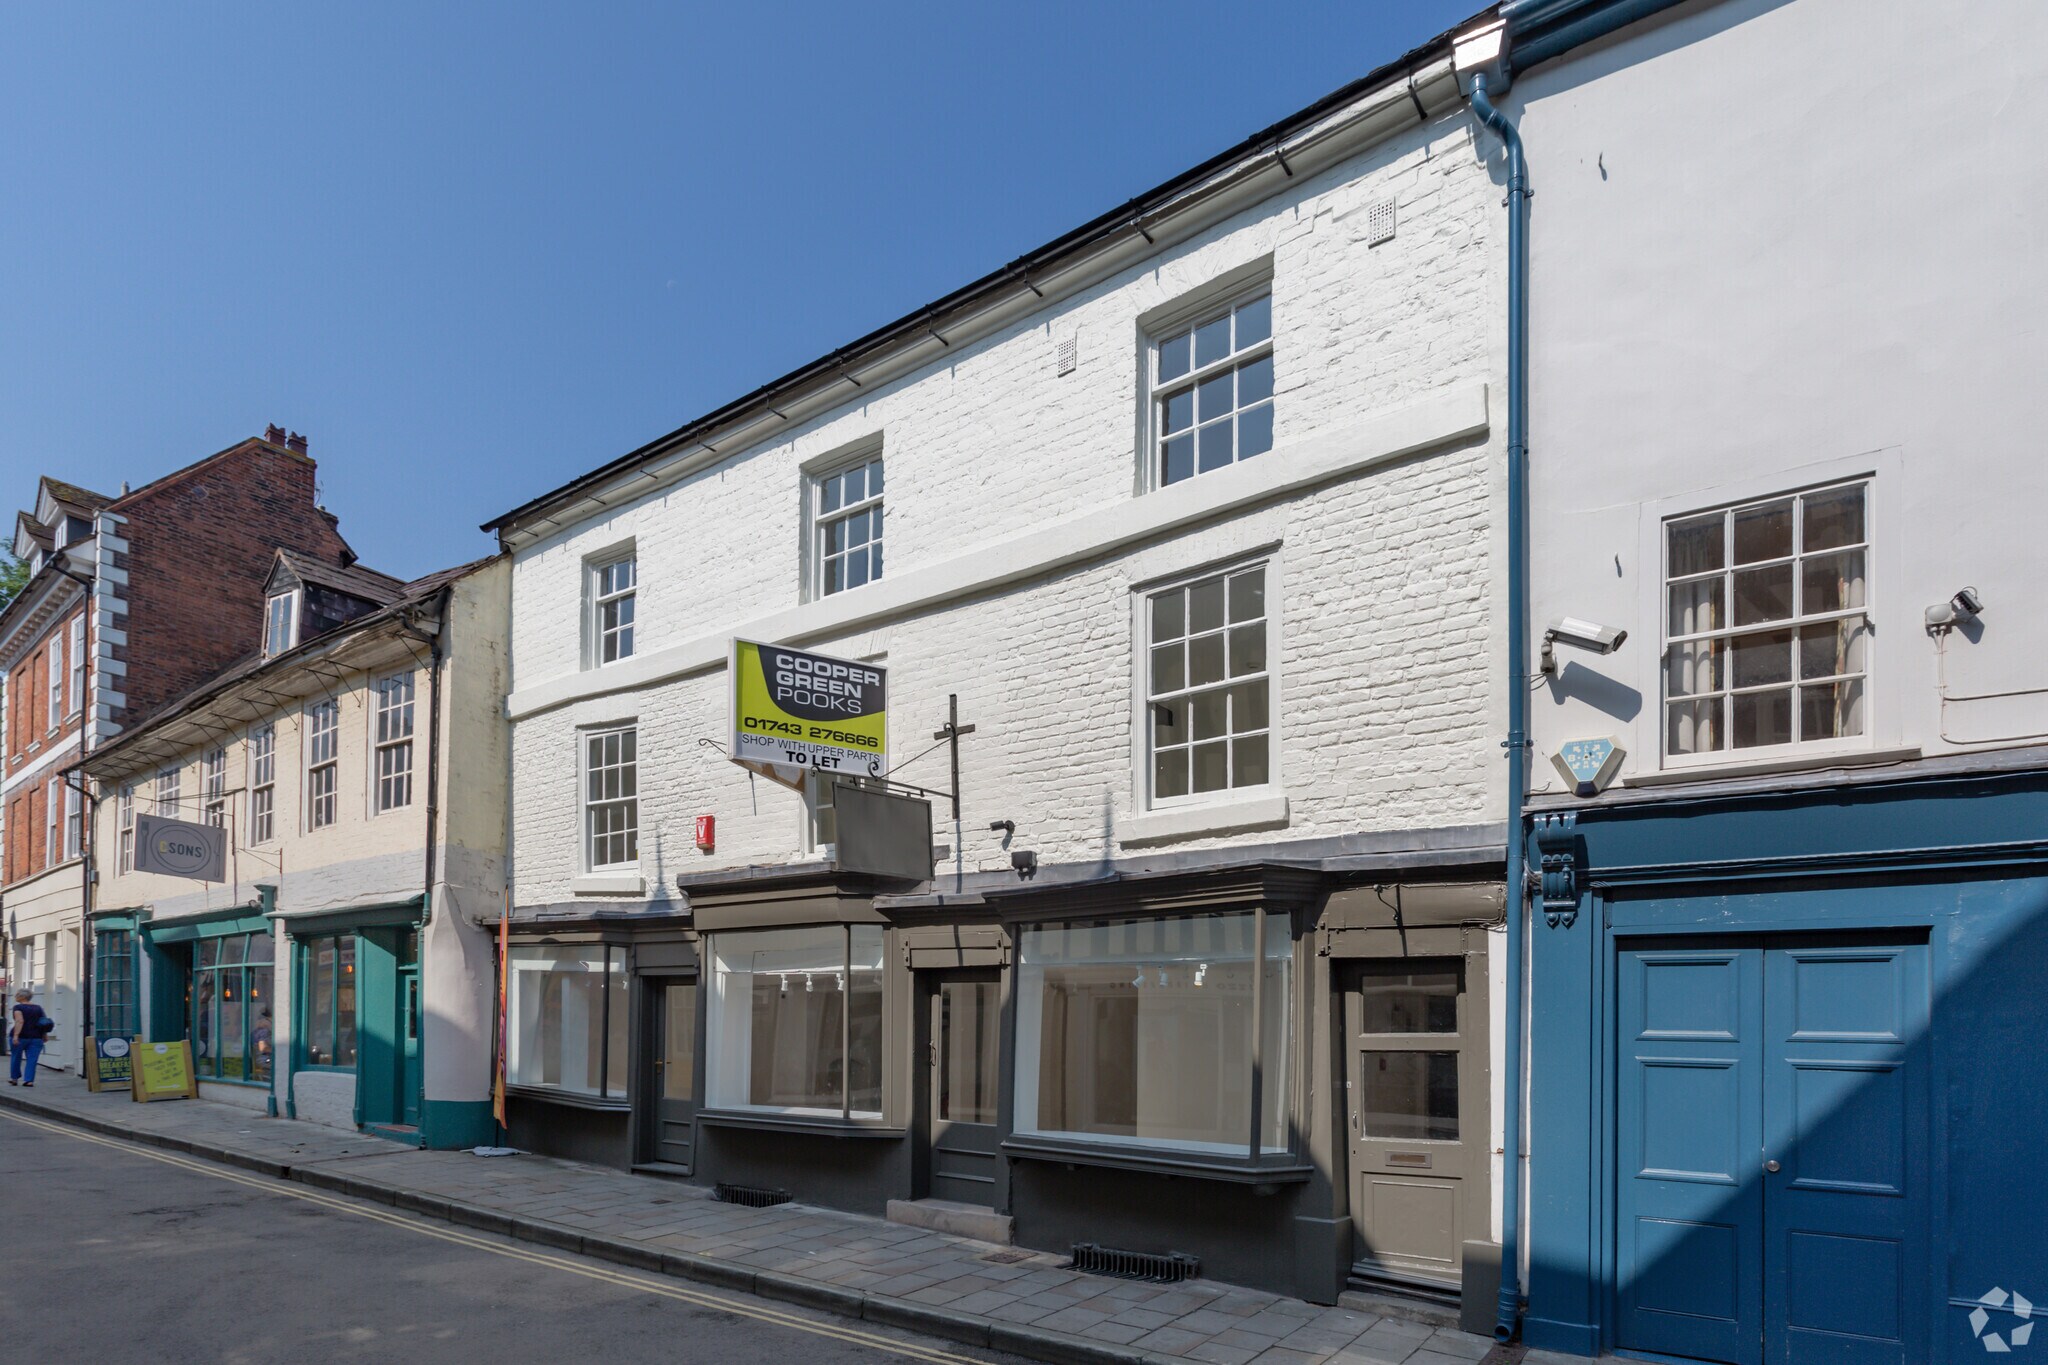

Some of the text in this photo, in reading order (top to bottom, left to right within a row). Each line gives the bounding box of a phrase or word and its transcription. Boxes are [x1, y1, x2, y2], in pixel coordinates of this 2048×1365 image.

[776, 654, 880, 686] COOPER
[776, 670, 862, 698] GREEN
[777, 686, 862, 714] POOKS
[744, 716, 878, 747] 01743 276666
[742, 734, 880, 763] SHOP WITH UPPER PARTS
[785, 750, 840, 769] TO LET
